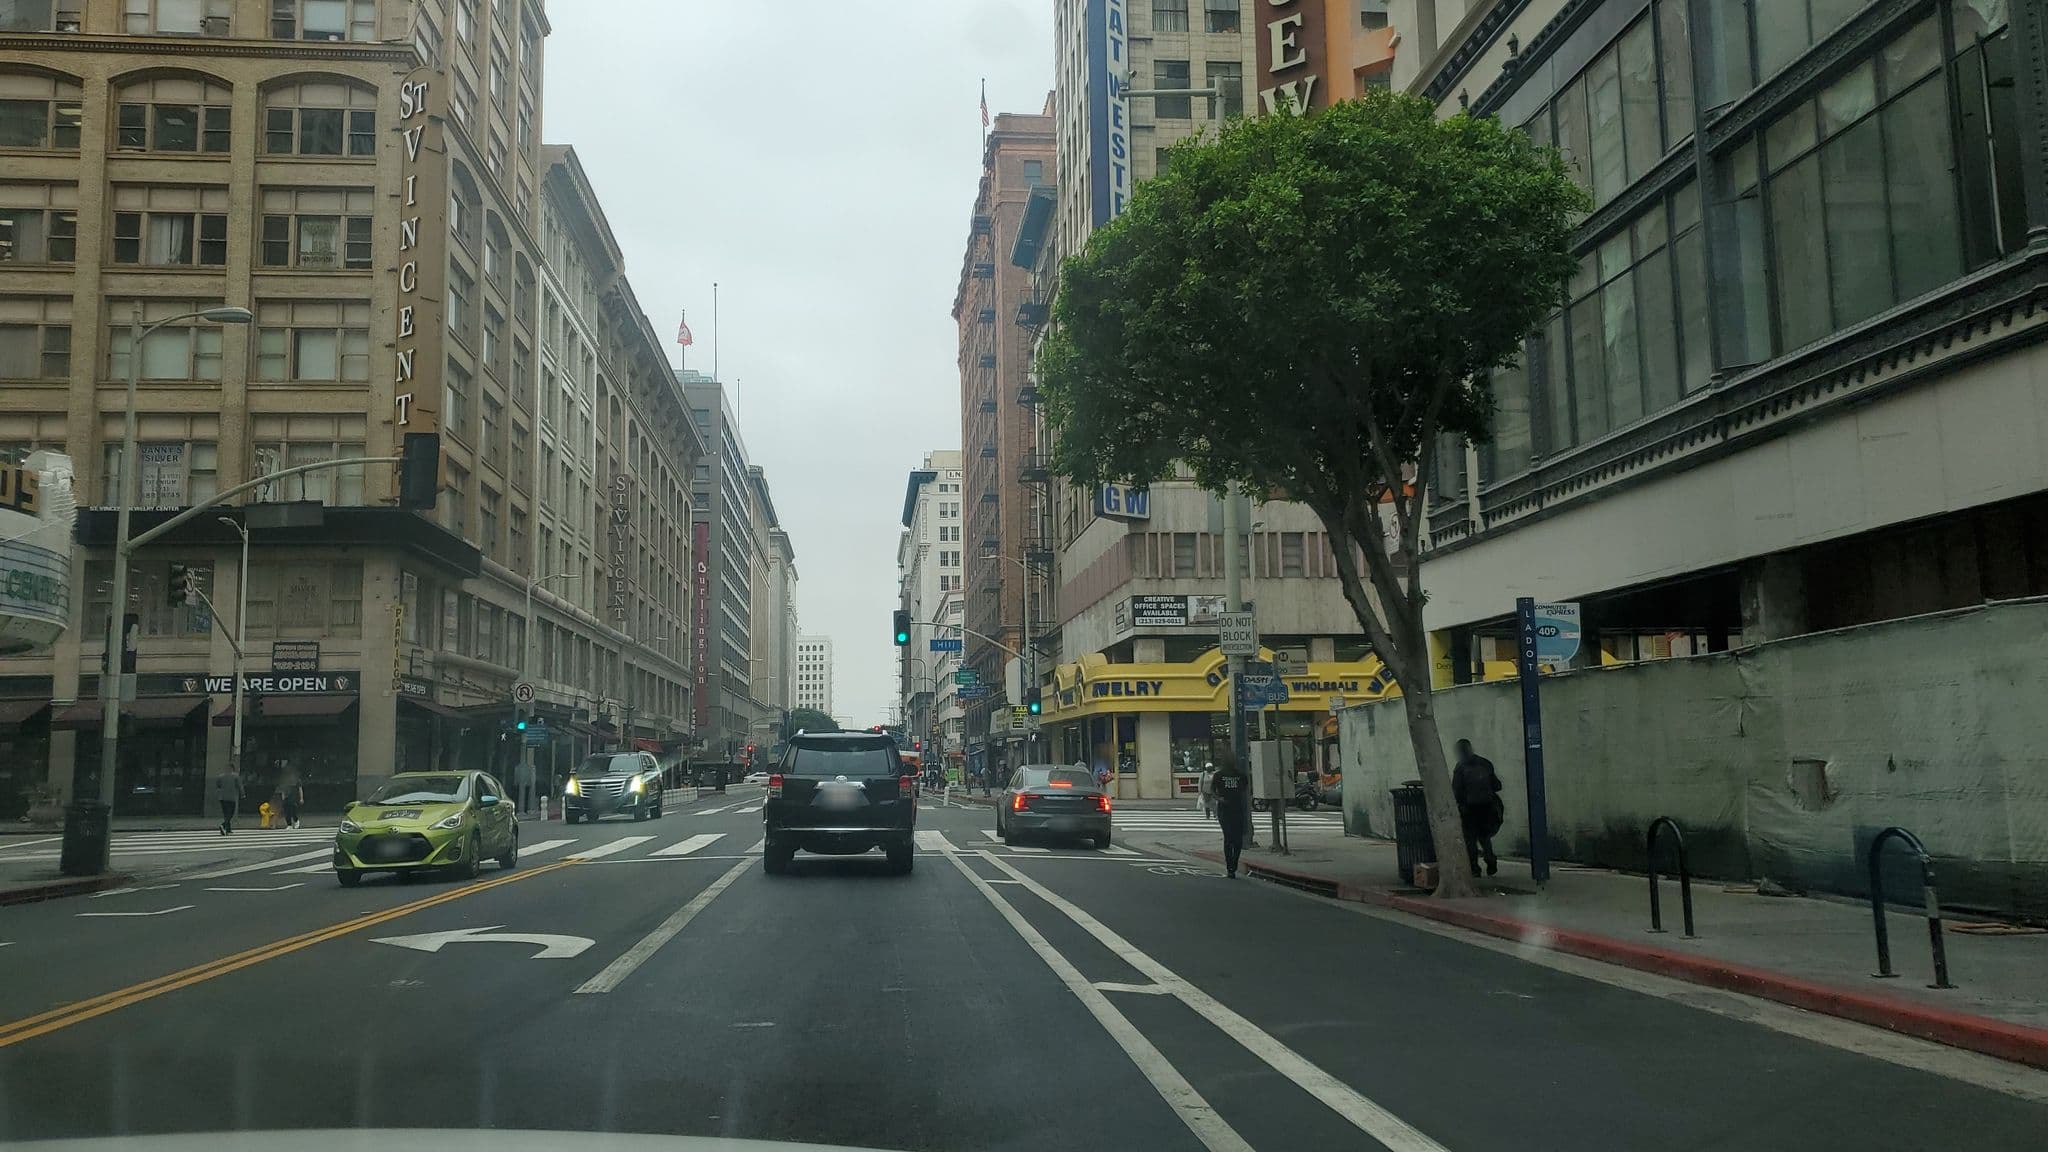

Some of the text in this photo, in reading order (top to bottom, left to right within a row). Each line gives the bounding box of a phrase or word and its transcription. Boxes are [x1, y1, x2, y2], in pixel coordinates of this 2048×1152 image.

[400, 80, 427, 120] ST
[396, 125, 425, 426] VINCENT
[614, 524, 628, 619] VINCENT
[697, 561, 707, 684] Burlington
[1221, 617, 1251, 627] DO NOT
[1539, 627, 1556, 635] 409
[393, 608, 402, 678] PARKING
[1223, 631, 1251, 641] BLOCK
[1525, 610, 1534, 671] LADOT
[205, 677, 327, 692] WE ARE OPEN
[1268, 692, 1286, 701] BUS
[1292, 681, 1358, 692] WHOLESALE
